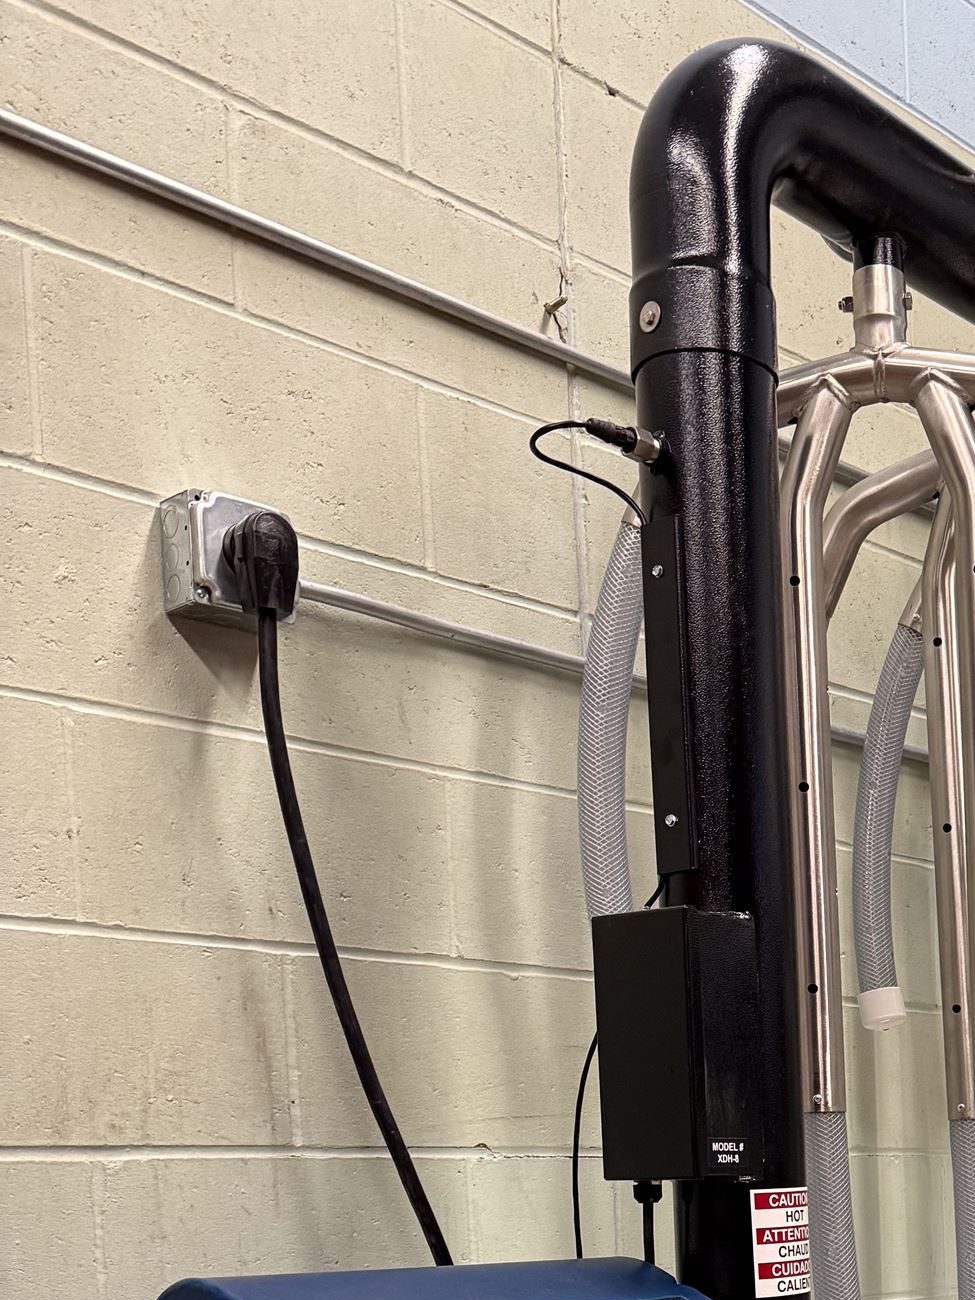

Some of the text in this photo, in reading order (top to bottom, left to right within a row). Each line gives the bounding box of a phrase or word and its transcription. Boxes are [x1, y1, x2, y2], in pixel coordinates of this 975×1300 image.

[712, 1142, 744, 1151] MODEL #
[717, 1154, 740, 1163] XDH-8
[768, 1192, 807, 1207] CAUTIO
[786, 1209, 804, 1222] HOT
[763, 1226, 809, 1243] ATTENTIO
[778, 1243, 808, 1258] CHAUD
[771, 1260, 810, 1277] CUIDAD
[777, 1277, 810, 1293] CALIEN
